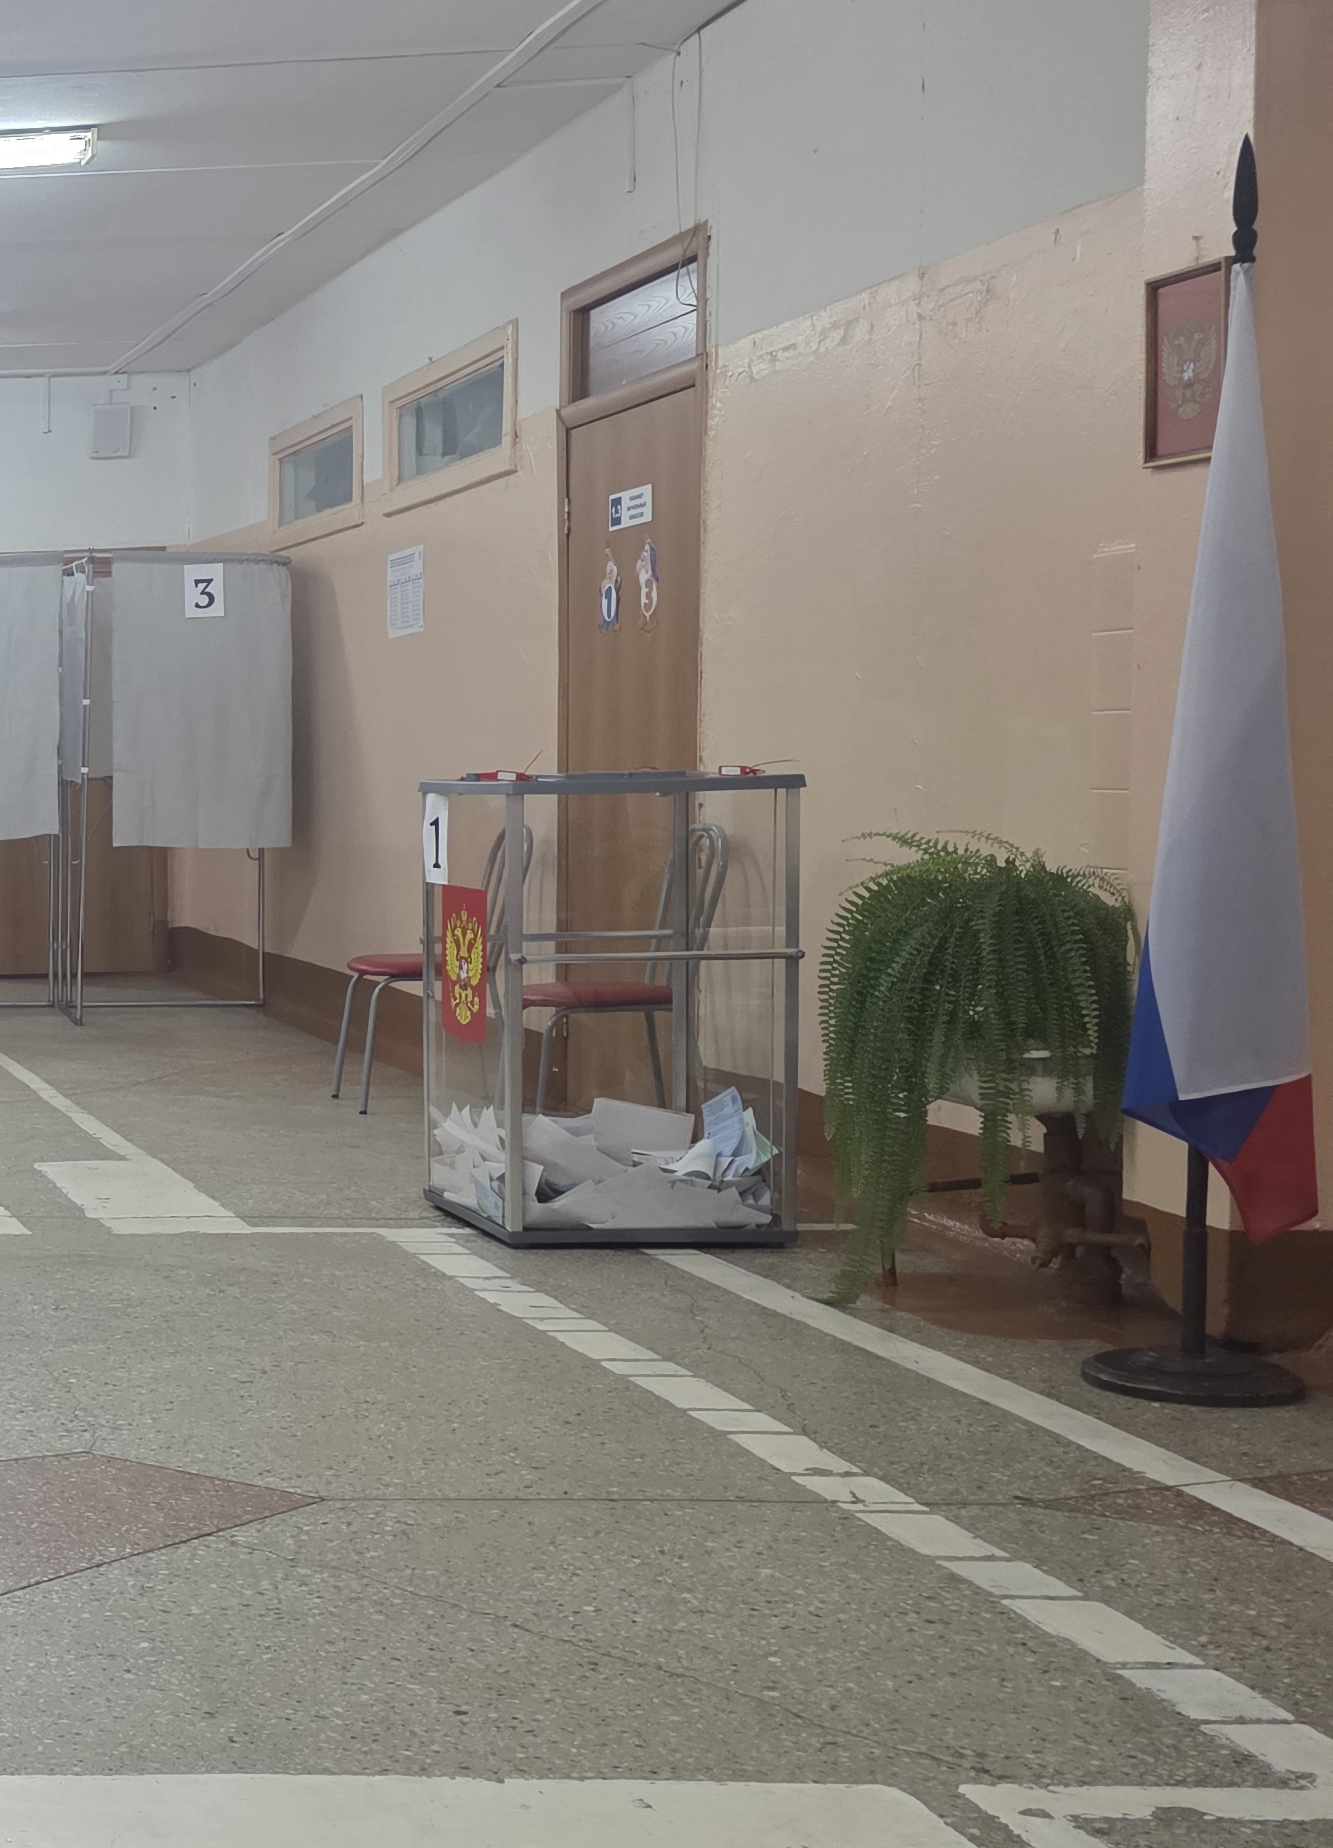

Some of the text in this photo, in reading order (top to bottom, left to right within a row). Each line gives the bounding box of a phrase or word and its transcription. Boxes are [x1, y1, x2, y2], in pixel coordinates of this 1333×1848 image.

[192, 578, 217, 609] 3
[604, 585, 613, 620] 1
[430, 816, 442, 869] 1
